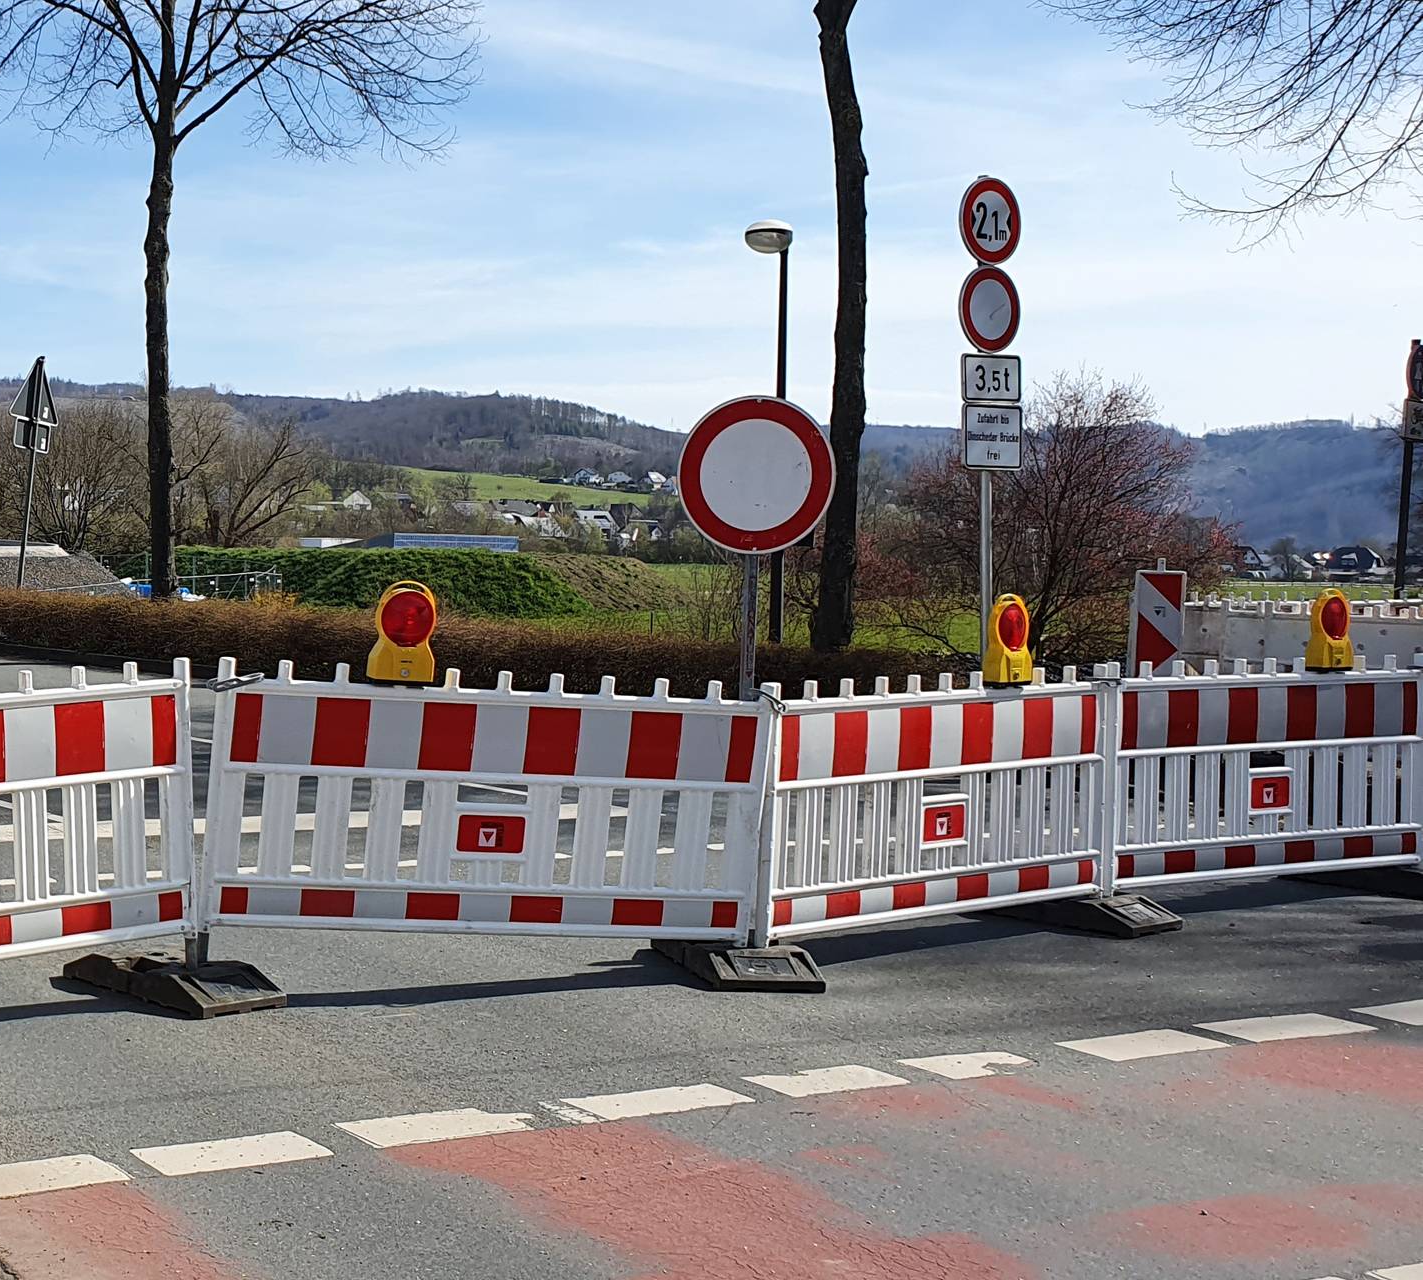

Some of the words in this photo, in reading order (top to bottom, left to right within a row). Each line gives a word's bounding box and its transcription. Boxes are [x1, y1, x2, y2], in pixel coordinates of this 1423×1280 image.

[977, 413, 998, 424] Zufahrt
[1000, 413, 1009, 425] bis
[987, 449, 1000, 460] frei
